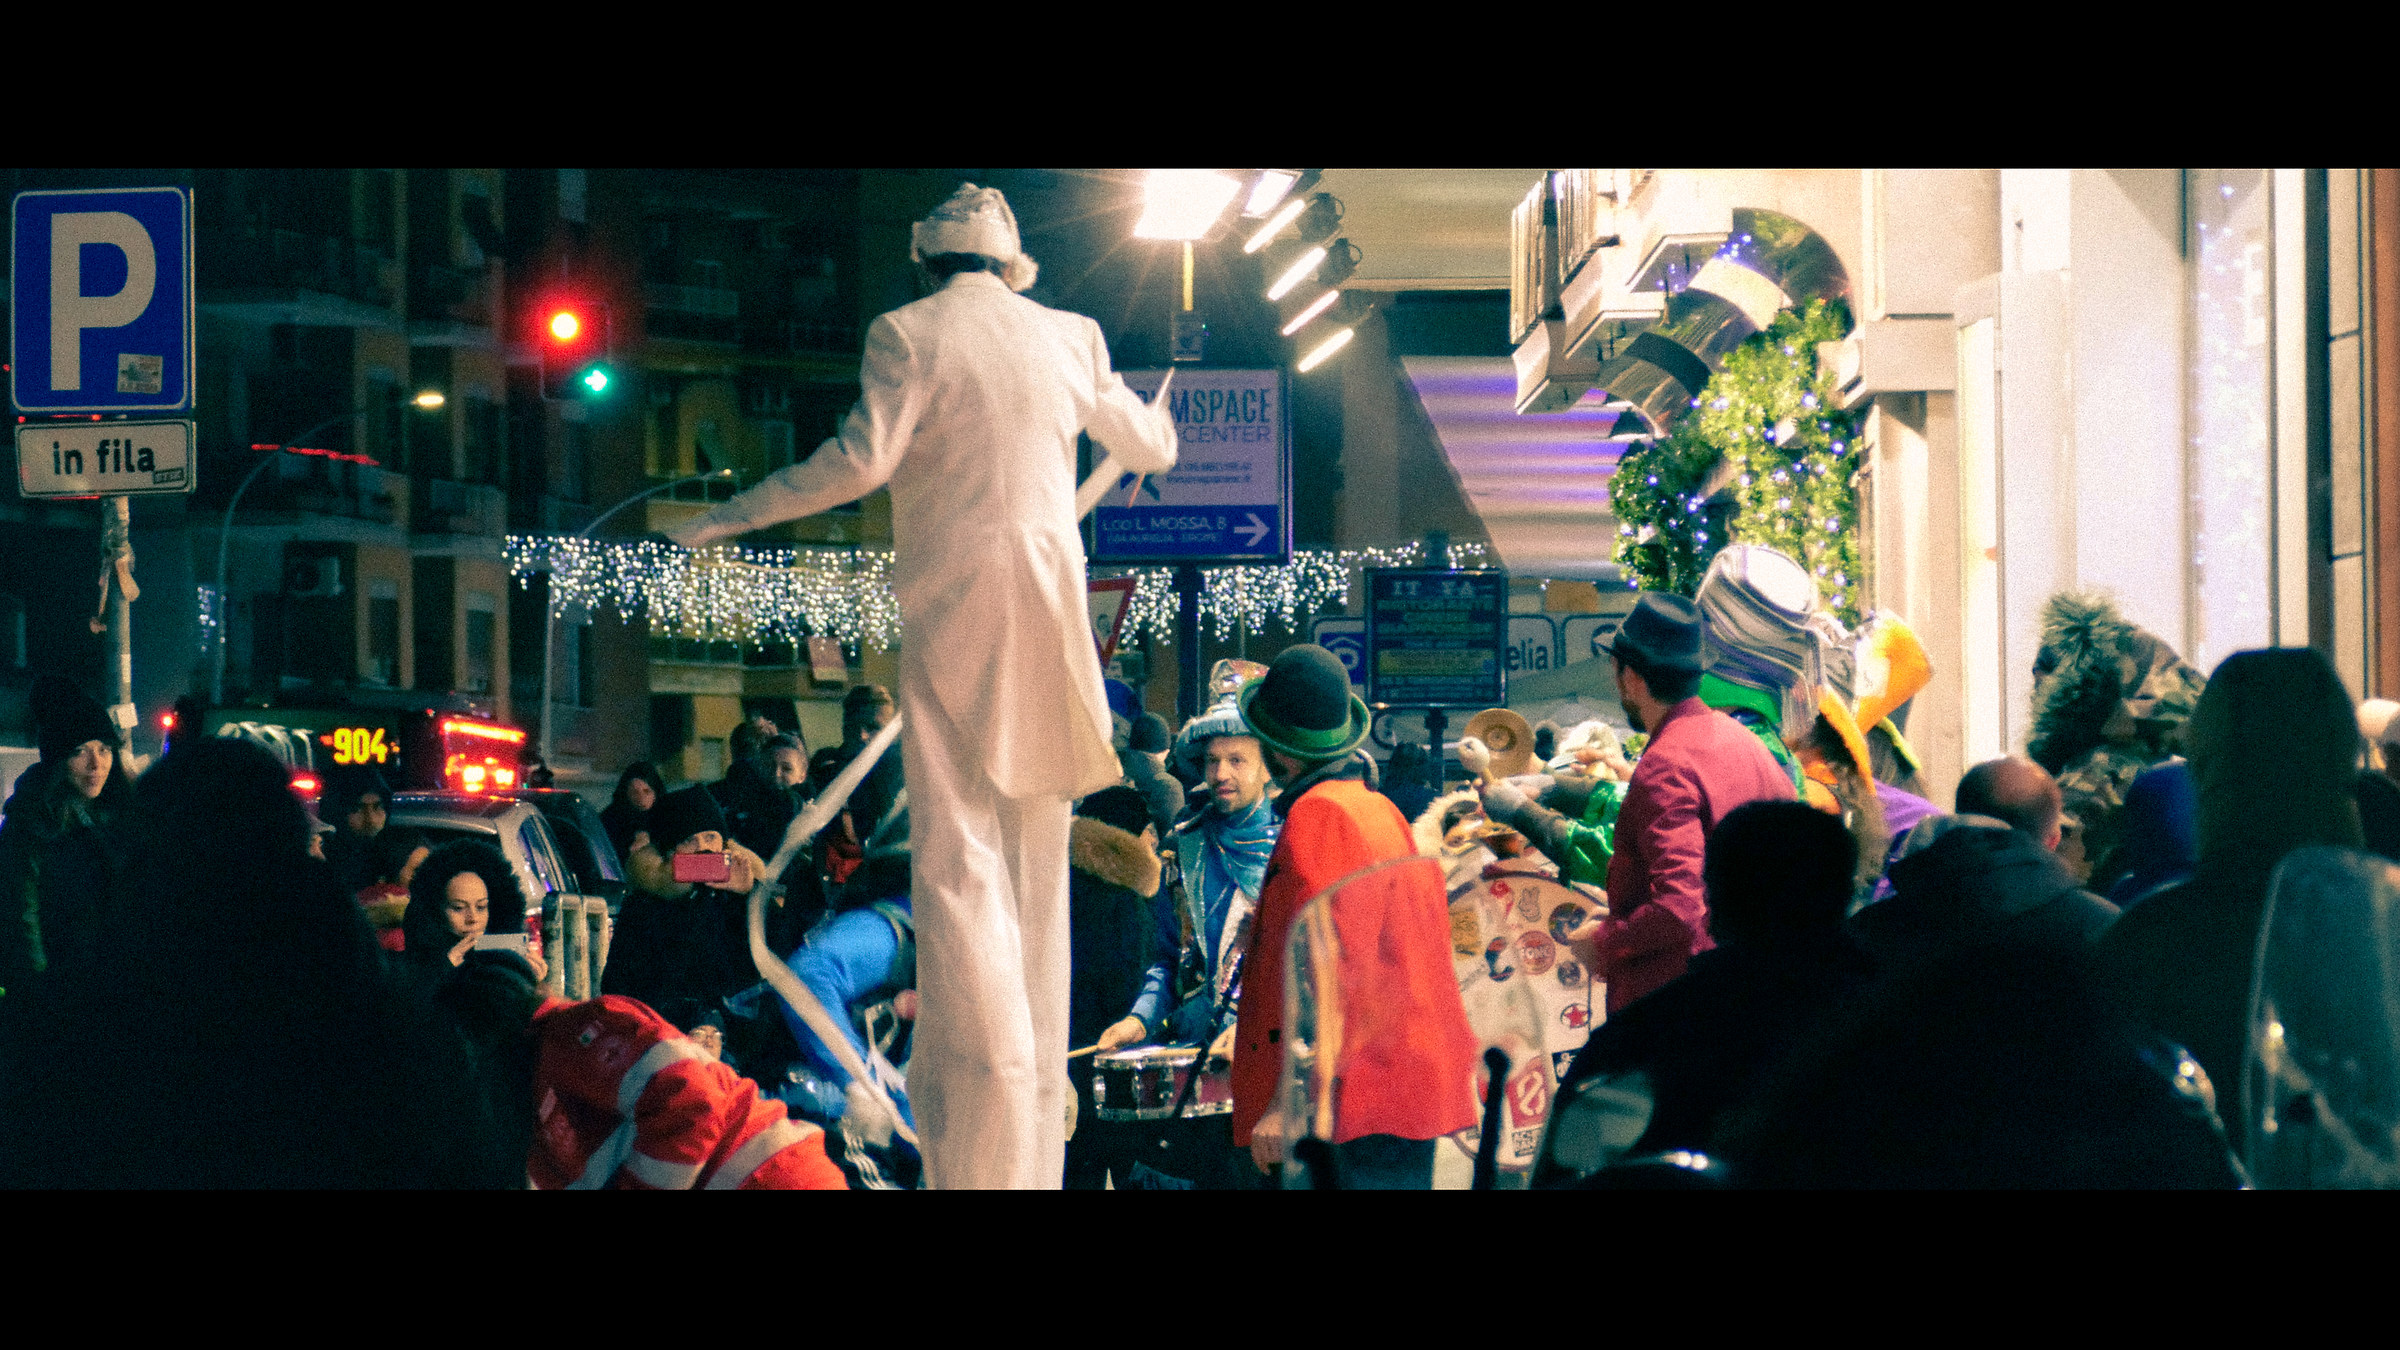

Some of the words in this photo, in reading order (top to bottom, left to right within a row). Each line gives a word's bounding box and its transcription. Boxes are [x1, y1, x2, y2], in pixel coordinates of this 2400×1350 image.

[51, 211, 156, 391] P
[1183, 425, 1271, 443] CENTER
[53, 441, 83, 476] in
[96, 438, 155, 474] fila
[1506, 637, 1548, 671] elia
[333, 727, 389, 765] 904
